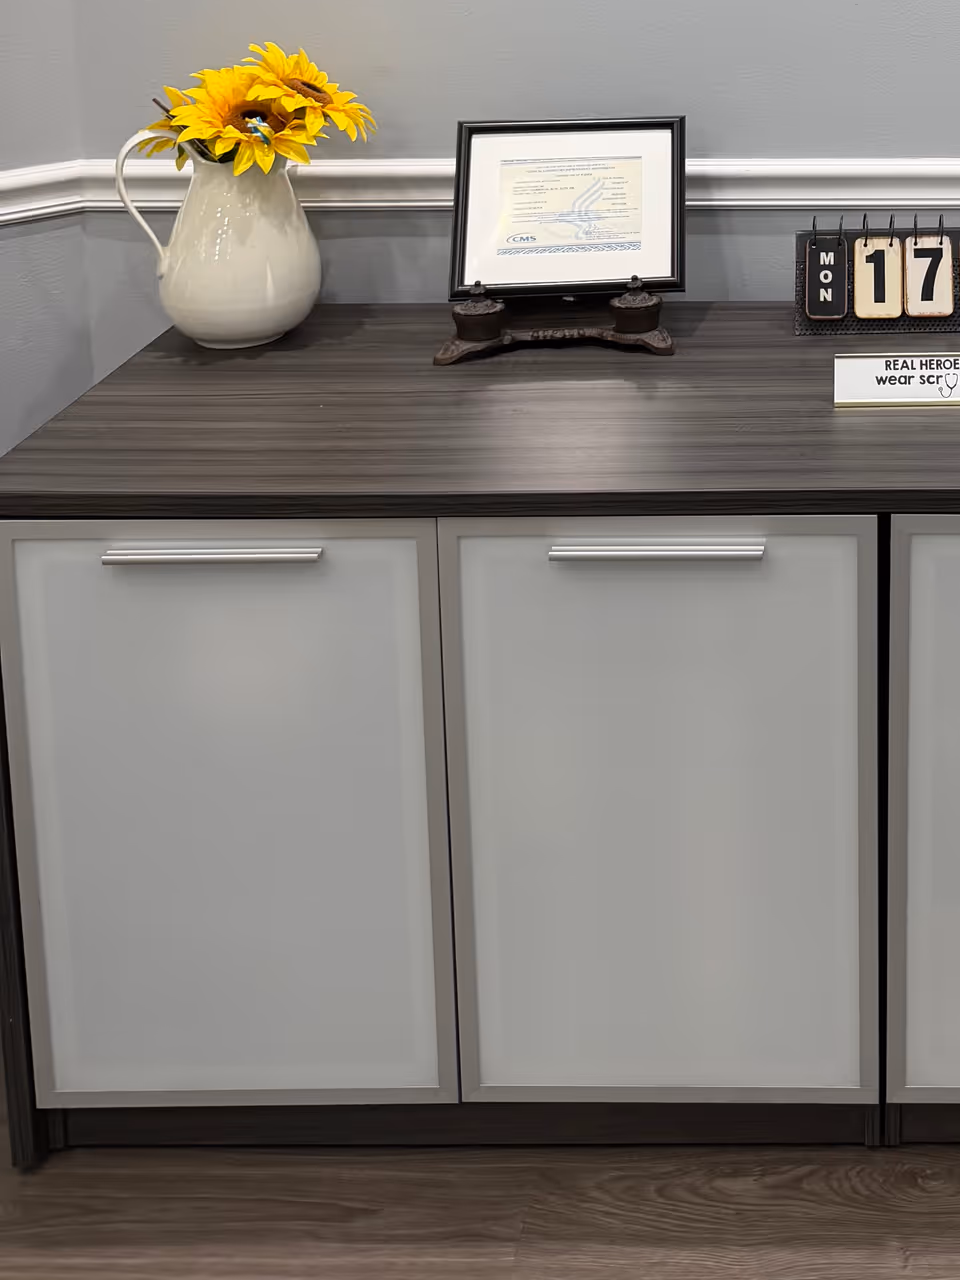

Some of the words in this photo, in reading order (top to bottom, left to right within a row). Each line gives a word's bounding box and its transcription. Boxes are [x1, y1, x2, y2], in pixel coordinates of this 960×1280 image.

[512, 235, 536, 243] CMS
[819, 252, 835, 302] MON
[885, 359, 916, 371] REAL
[875, 373, 915, 385] wear
